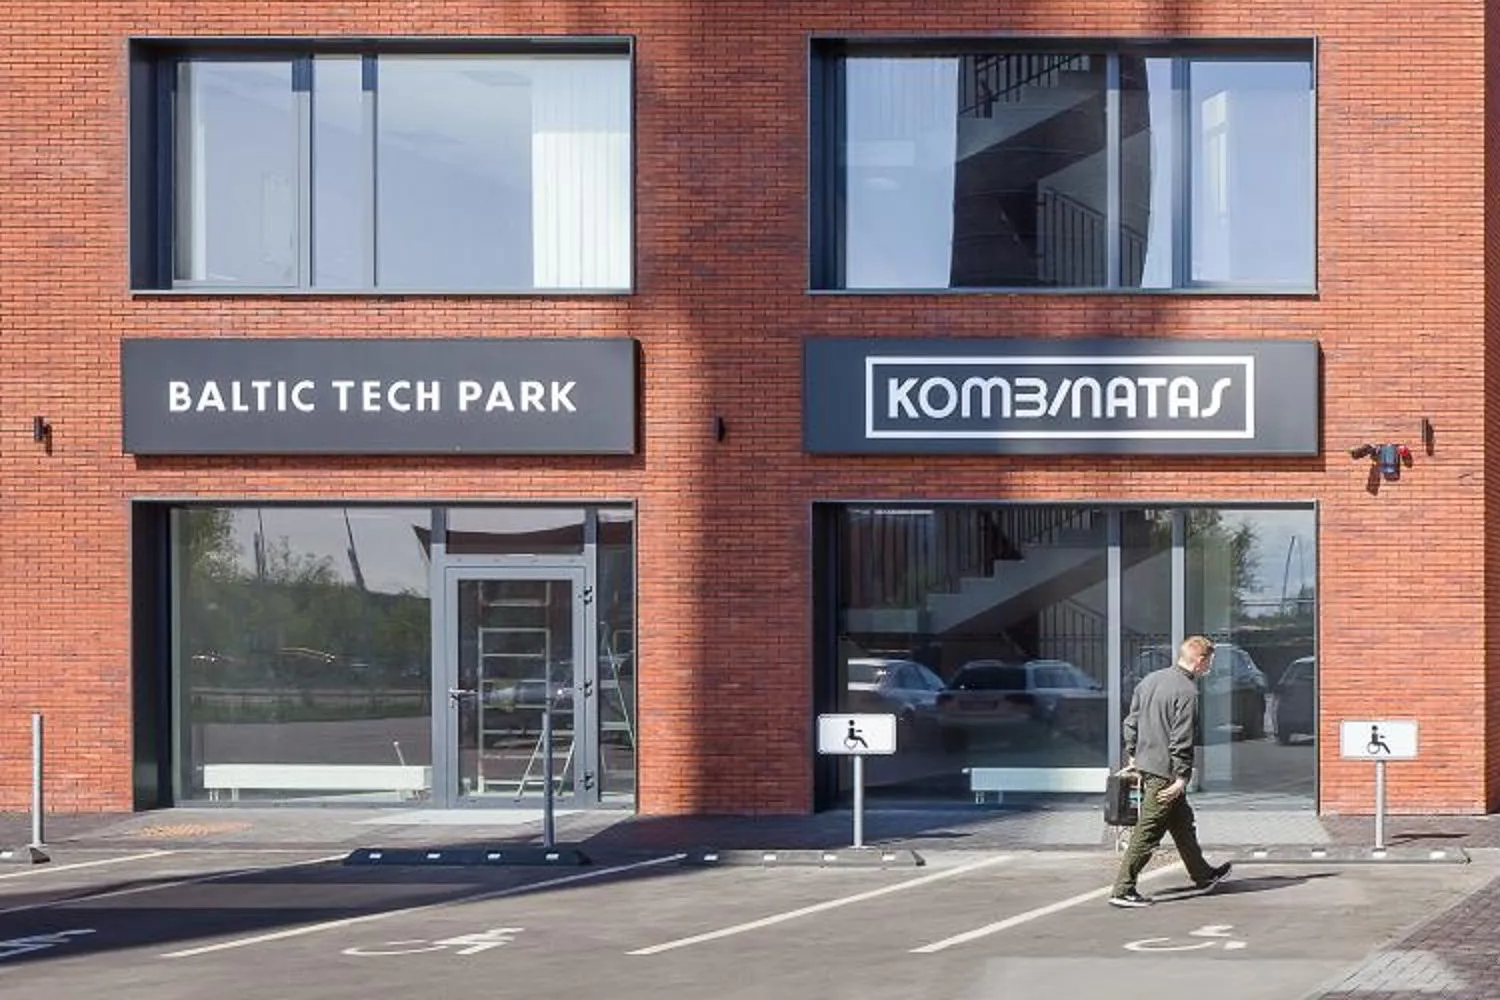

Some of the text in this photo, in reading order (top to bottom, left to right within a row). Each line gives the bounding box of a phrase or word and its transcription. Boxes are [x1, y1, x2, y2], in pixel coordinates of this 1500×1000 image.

[168, 380, 577, 412] BALTIC TECH PARK
[888, 376, 1232, 418] KOMBINATAS
